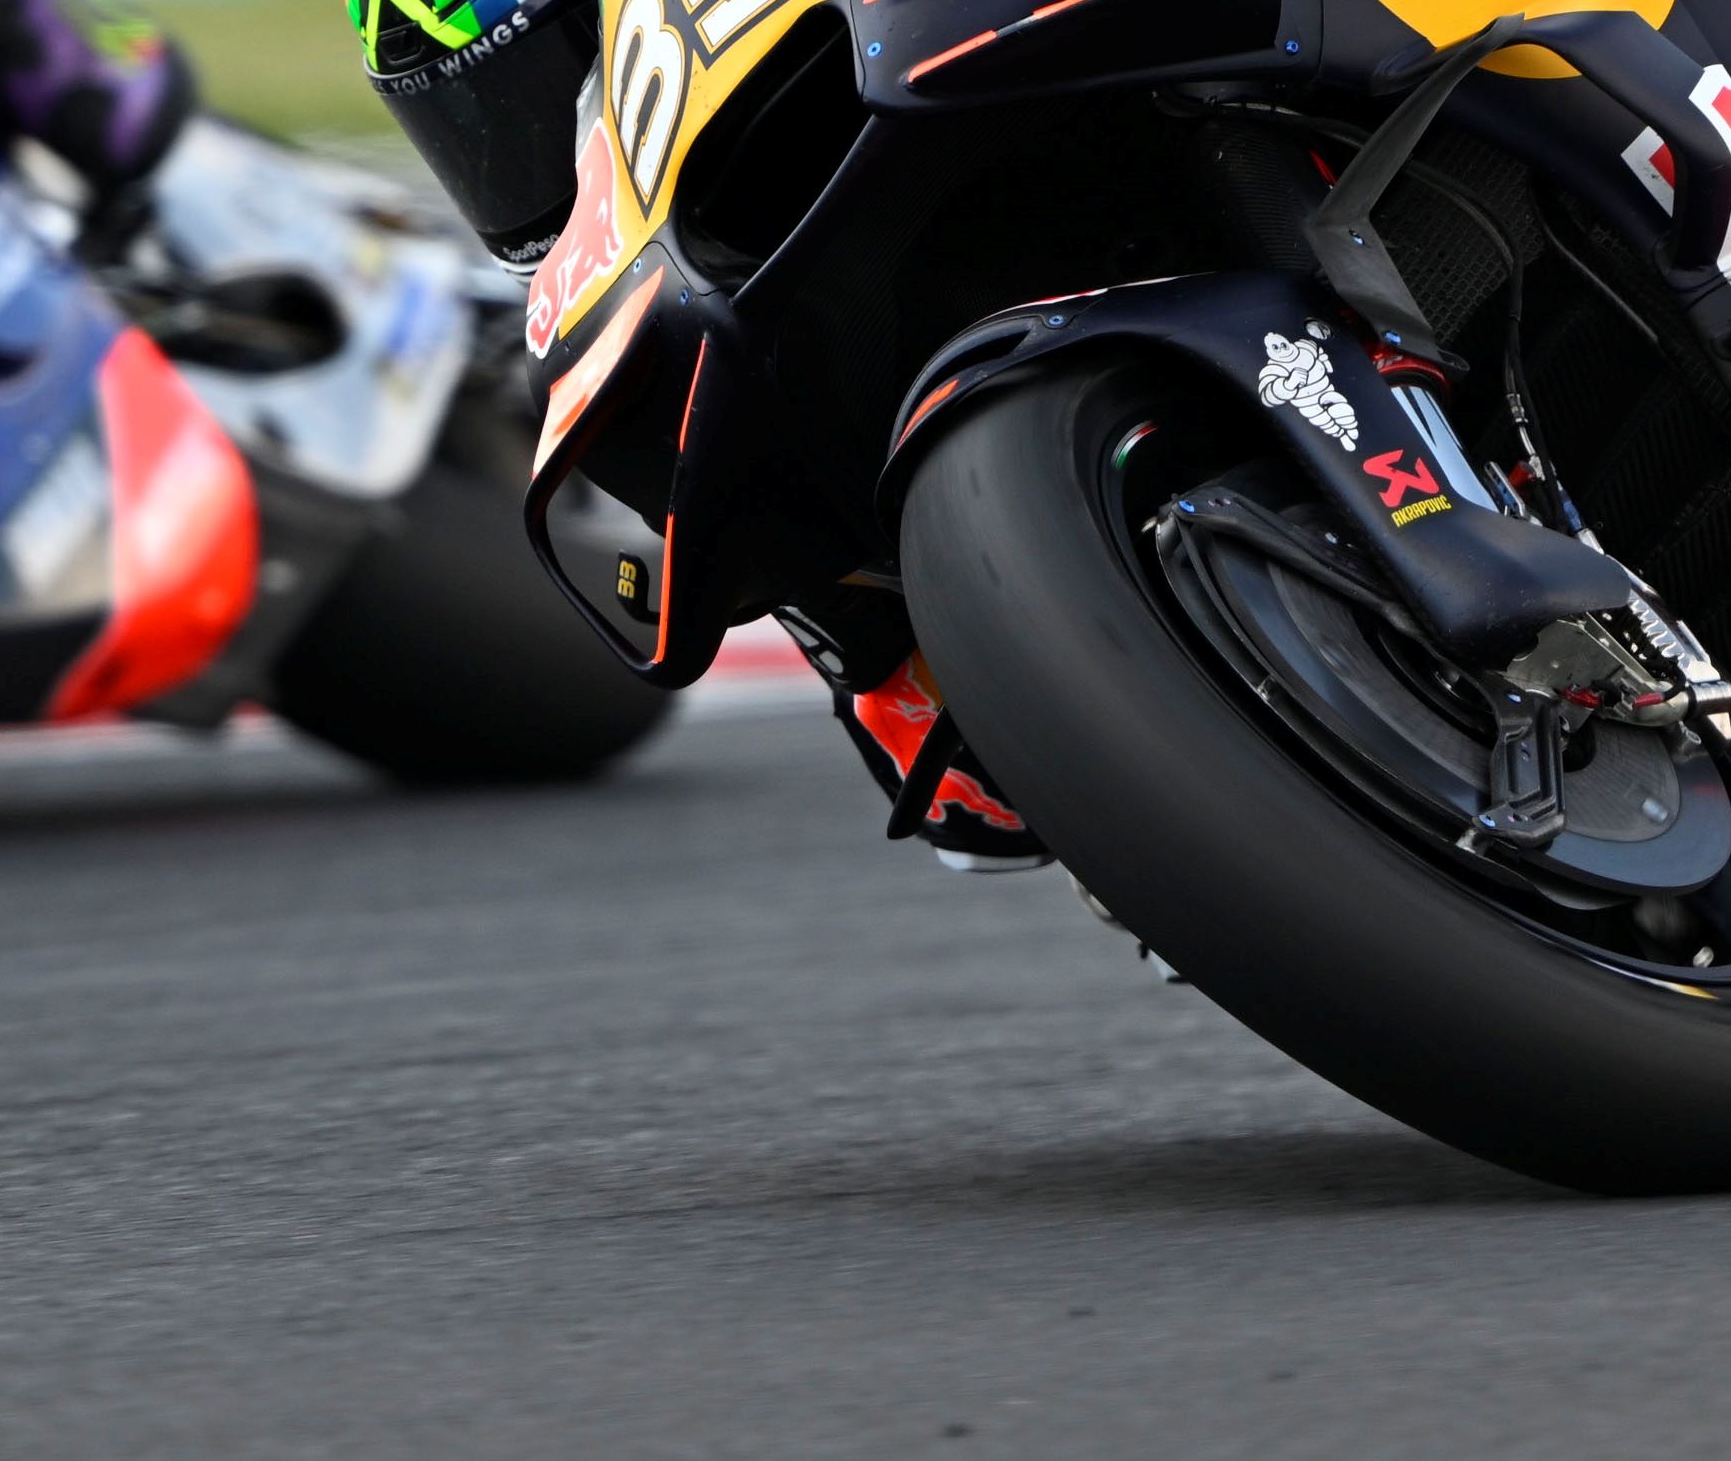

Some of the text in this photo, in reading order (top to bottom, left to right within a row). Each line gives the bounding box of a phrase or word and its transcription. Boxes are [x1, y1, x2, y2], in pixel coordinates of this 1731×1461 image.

[390, 10, 531, 97] YOU WINGS
[617, 560, 637, 599] 33
